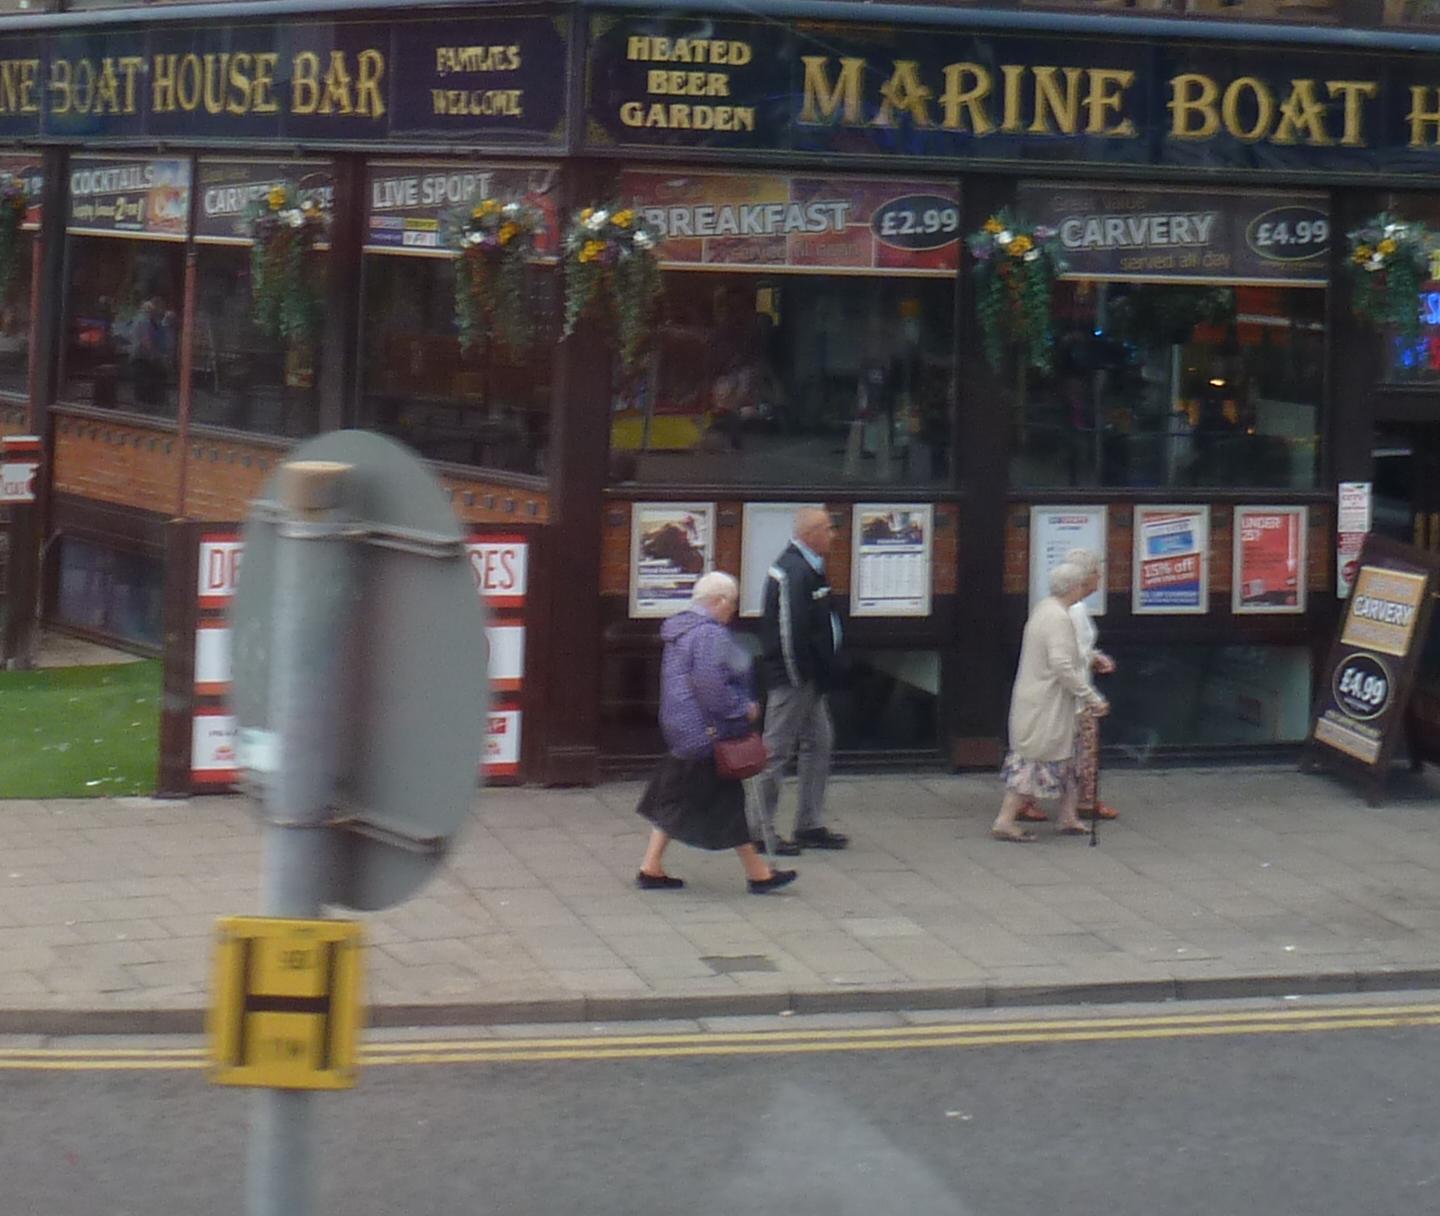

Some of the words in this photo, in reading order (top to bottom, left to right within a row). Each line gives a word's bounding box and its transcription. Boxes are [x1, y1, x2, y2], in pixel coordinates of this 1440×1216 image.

[436, 46, 521, 73] FAMILIES
[627, 36, 752, 65] HEATED
[50, 58, 146, 115] BOAT
[152, 51, 280, 115] HOUSE
[290, 48, 387, 118] BAR
[647, 70, 730, 96] BEER
[431, 89, 524, 117] WELCOME
[620, 101, 756, 131] GARDEN
[799, 55, 1136, 138] MARINE
[1167, 73, 1378, 148] BOAT
[71, 165, 154, 195] COCKTAILS
[372, 177, 418, 208] LIVE
[423, 173, 493, 204] SPORT
[645, 202, 850, 237] BREAKFAST
[880, 208, 958, 237] £2.99
[1060, 214, 1215, 248] CARVERY
[1256, 220, 1329, 246] £4.99
[1353, 596, 1416, 626] CARVERY
[1339, 666, 1387, 705] £4.99
